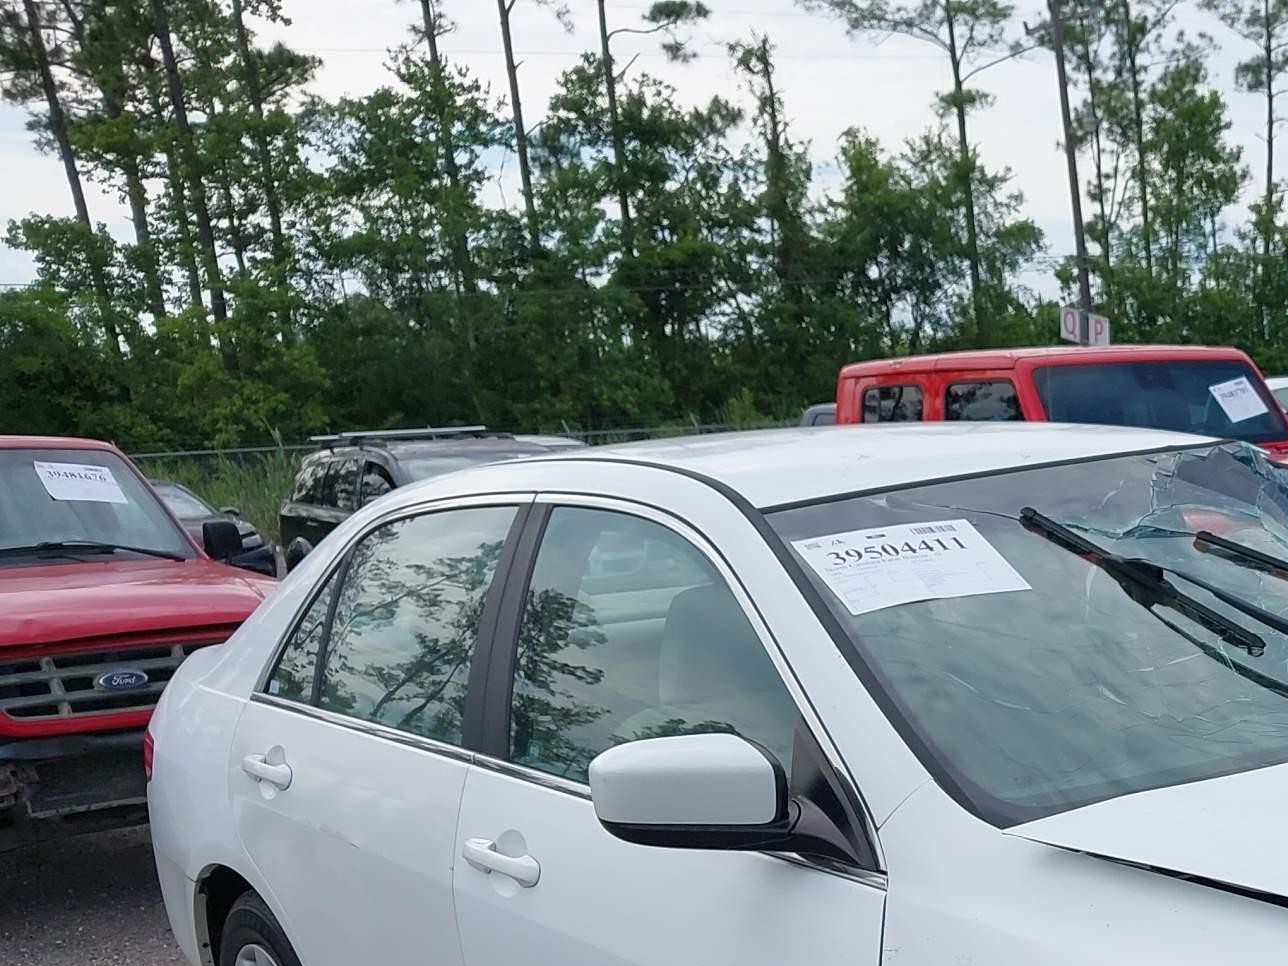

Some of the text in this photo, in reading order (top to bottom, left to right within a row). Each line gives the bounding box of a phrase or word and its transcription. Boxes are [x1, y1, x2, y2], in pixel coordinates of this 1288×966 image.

[1064, 311, 1077, 338] Q
[1094, 319, 1105, 345] P
[826, 536, 967, 566] 39504411
[111, 674, 136, 686] Ford
